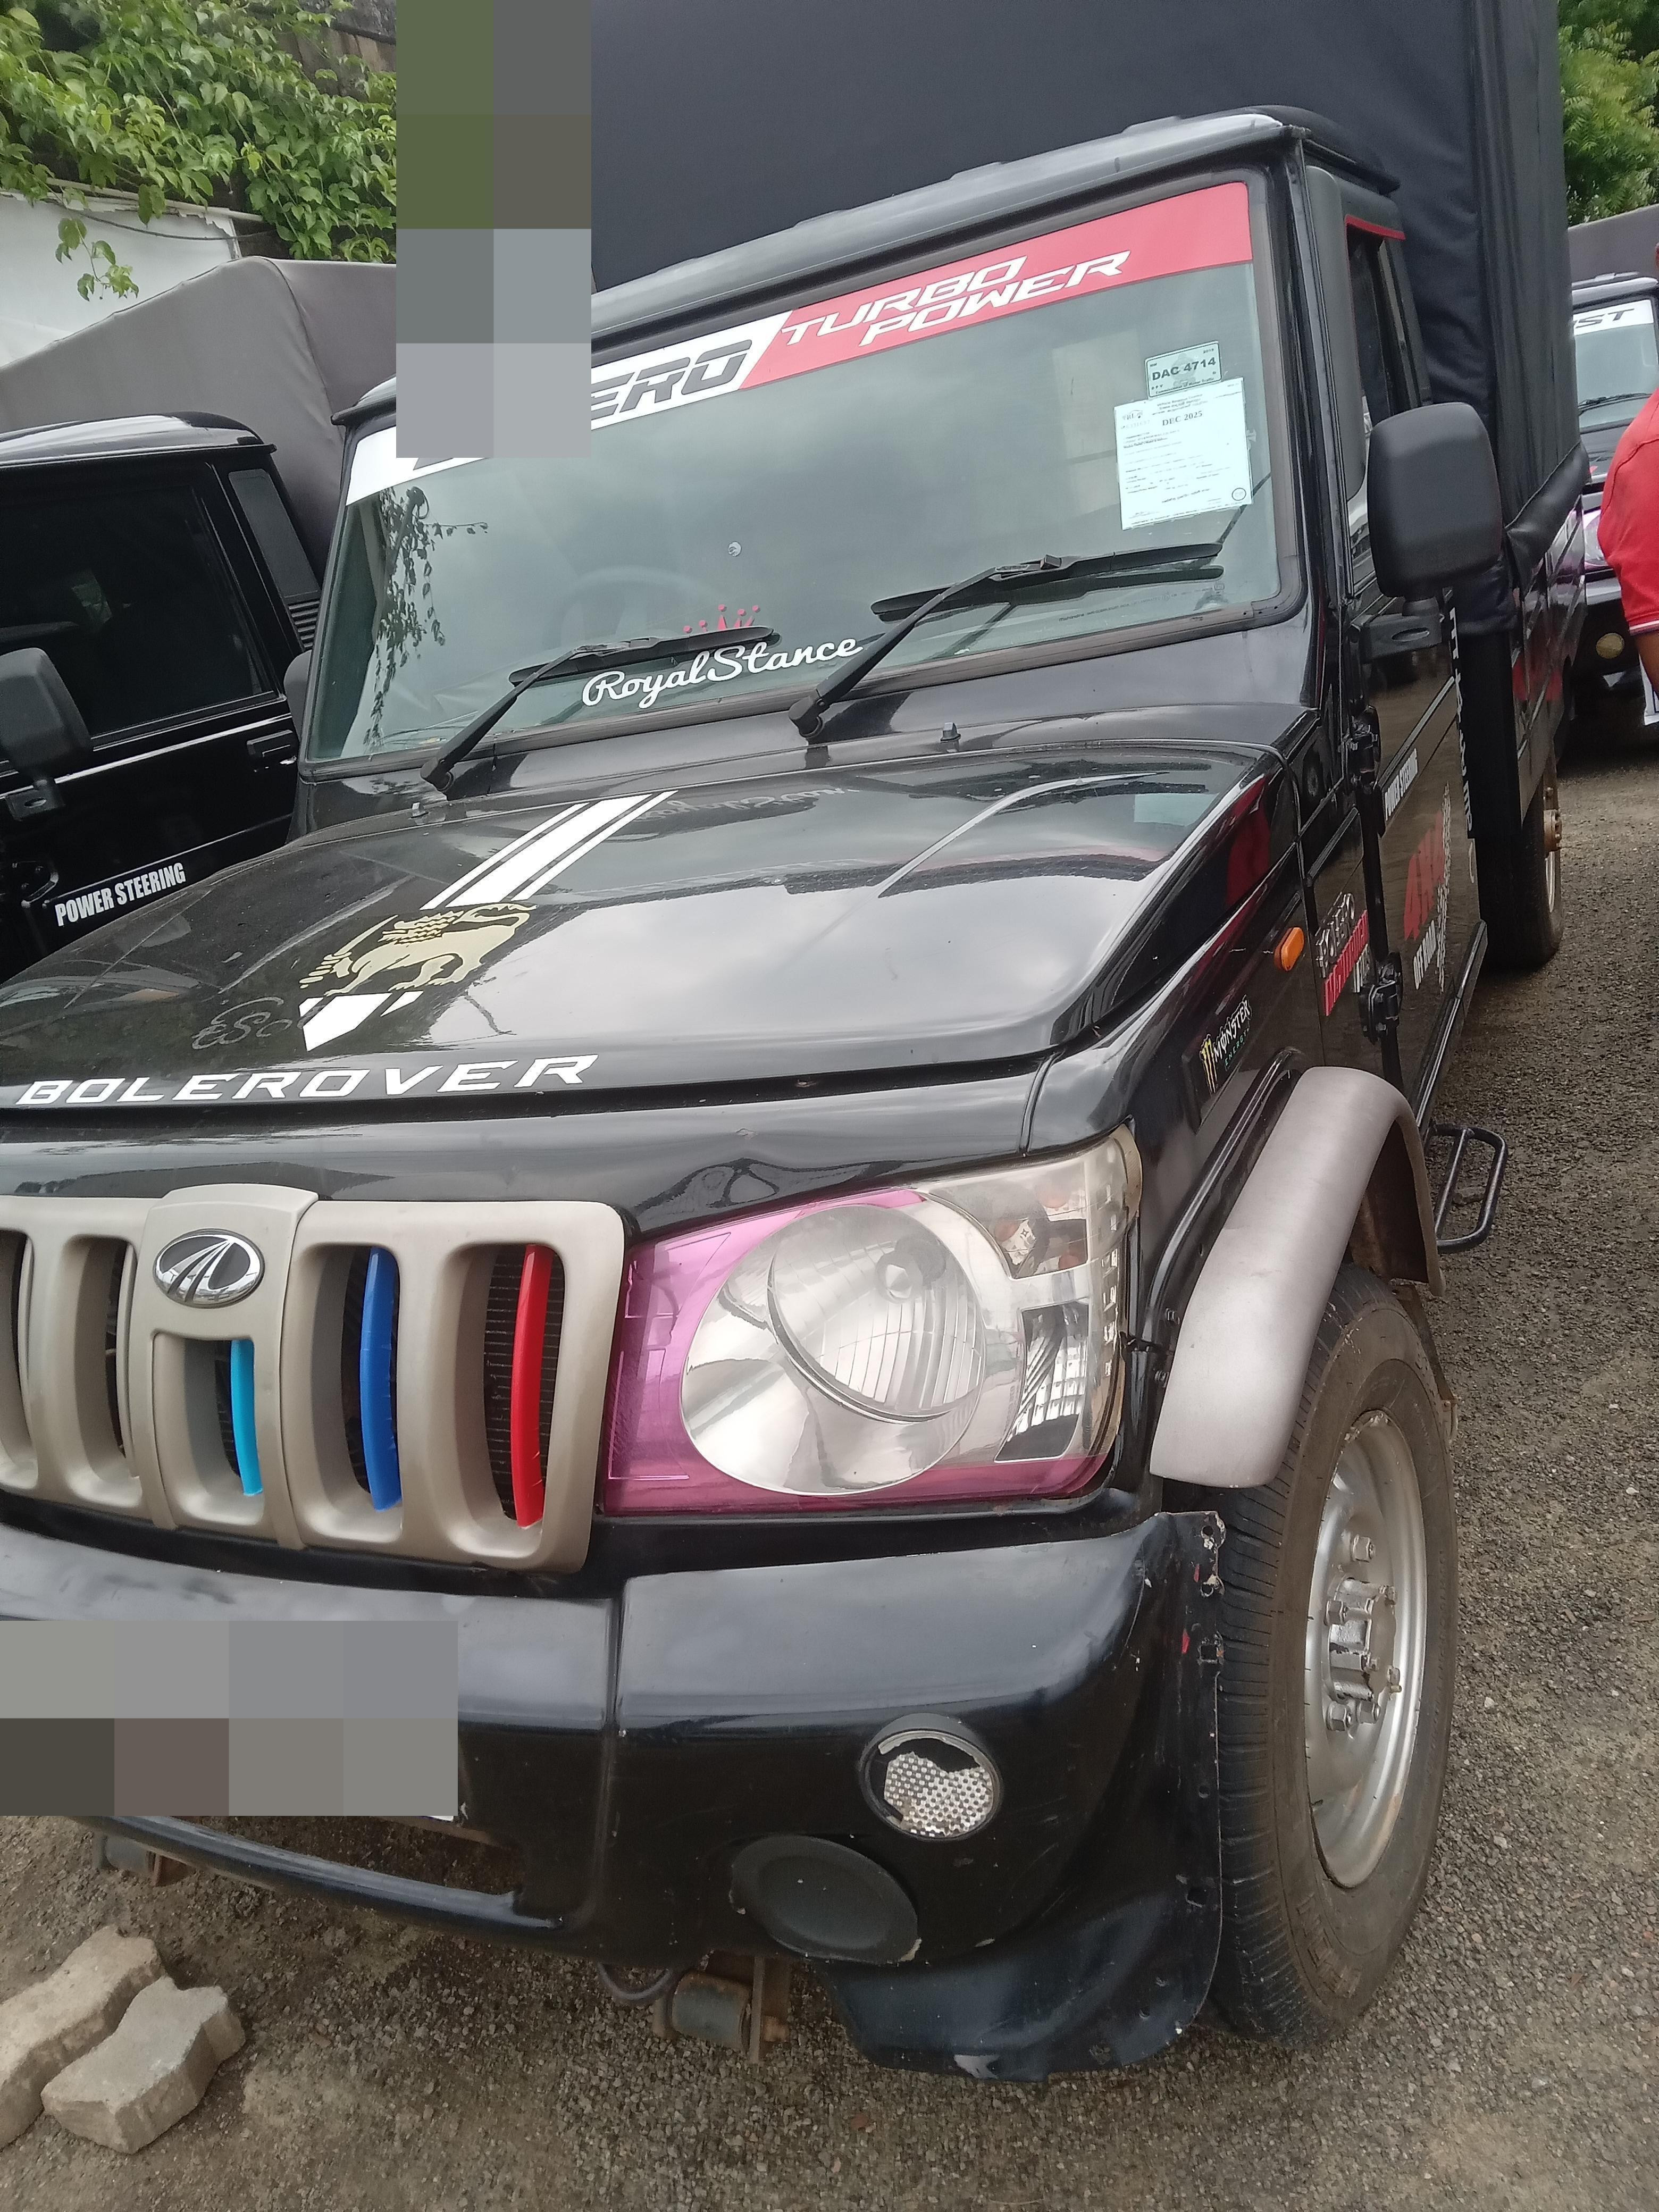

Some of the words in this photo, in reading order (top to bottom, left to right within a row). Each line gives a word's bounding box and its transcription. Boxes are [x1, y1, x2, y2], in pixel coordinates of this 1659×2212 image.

[781, 255, 1027, 346] TURBO
[858, 250, 1131, 348] POWER
[1569, 308, 1635, 329] ST
[1152, 366, 1180, 381] DAC
[1183, 357, 1217, 372] 4714
[1162, 415, 1182, 426] DEC
[1184, 410, 1203, 421] 2025
[55, 887, 115, 927] POWER
[114, 862, 187, 905] STEERING
[16, 1053, 599, 1105] BOLEROVER
